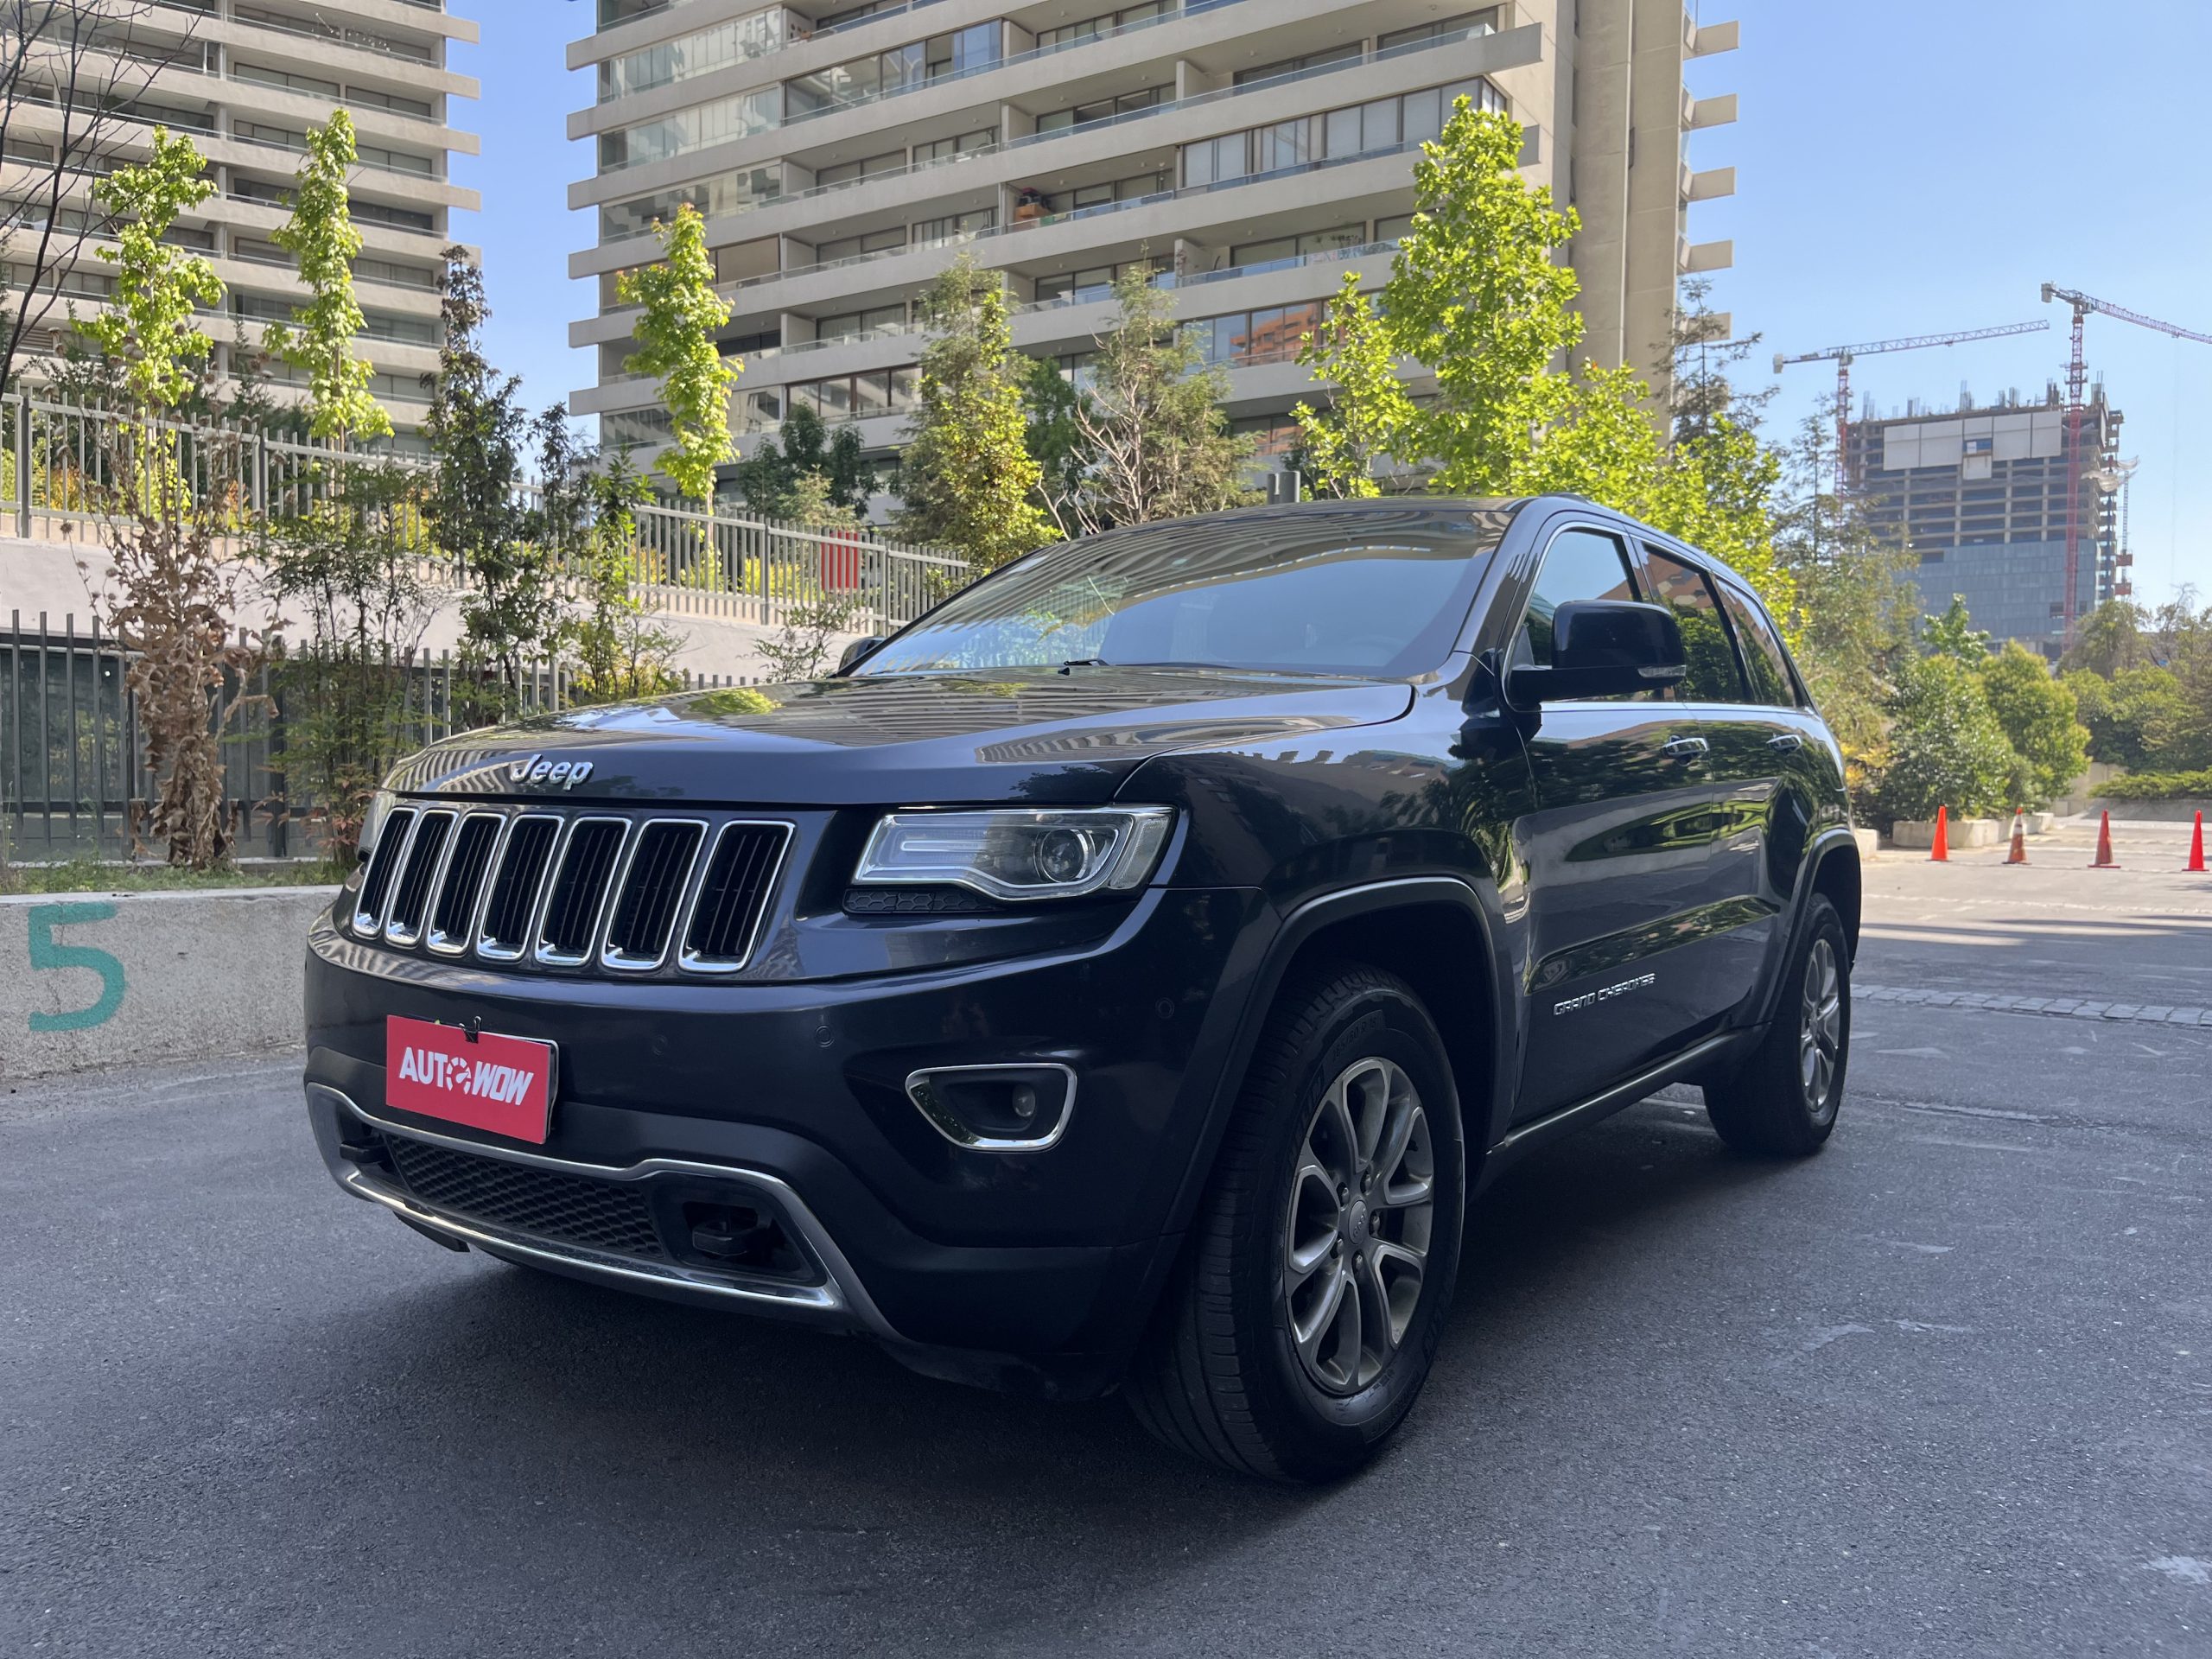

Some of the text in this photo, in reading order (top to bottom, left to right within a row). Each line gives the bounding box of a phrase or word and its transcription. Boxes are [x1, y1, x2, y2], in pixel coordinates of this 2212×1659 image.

[511, 753, 594, 791] Jeep
[28, 901, 126, 1032] 5
[1554, 973, 1655, 1015] GRAND CHEROKEE
